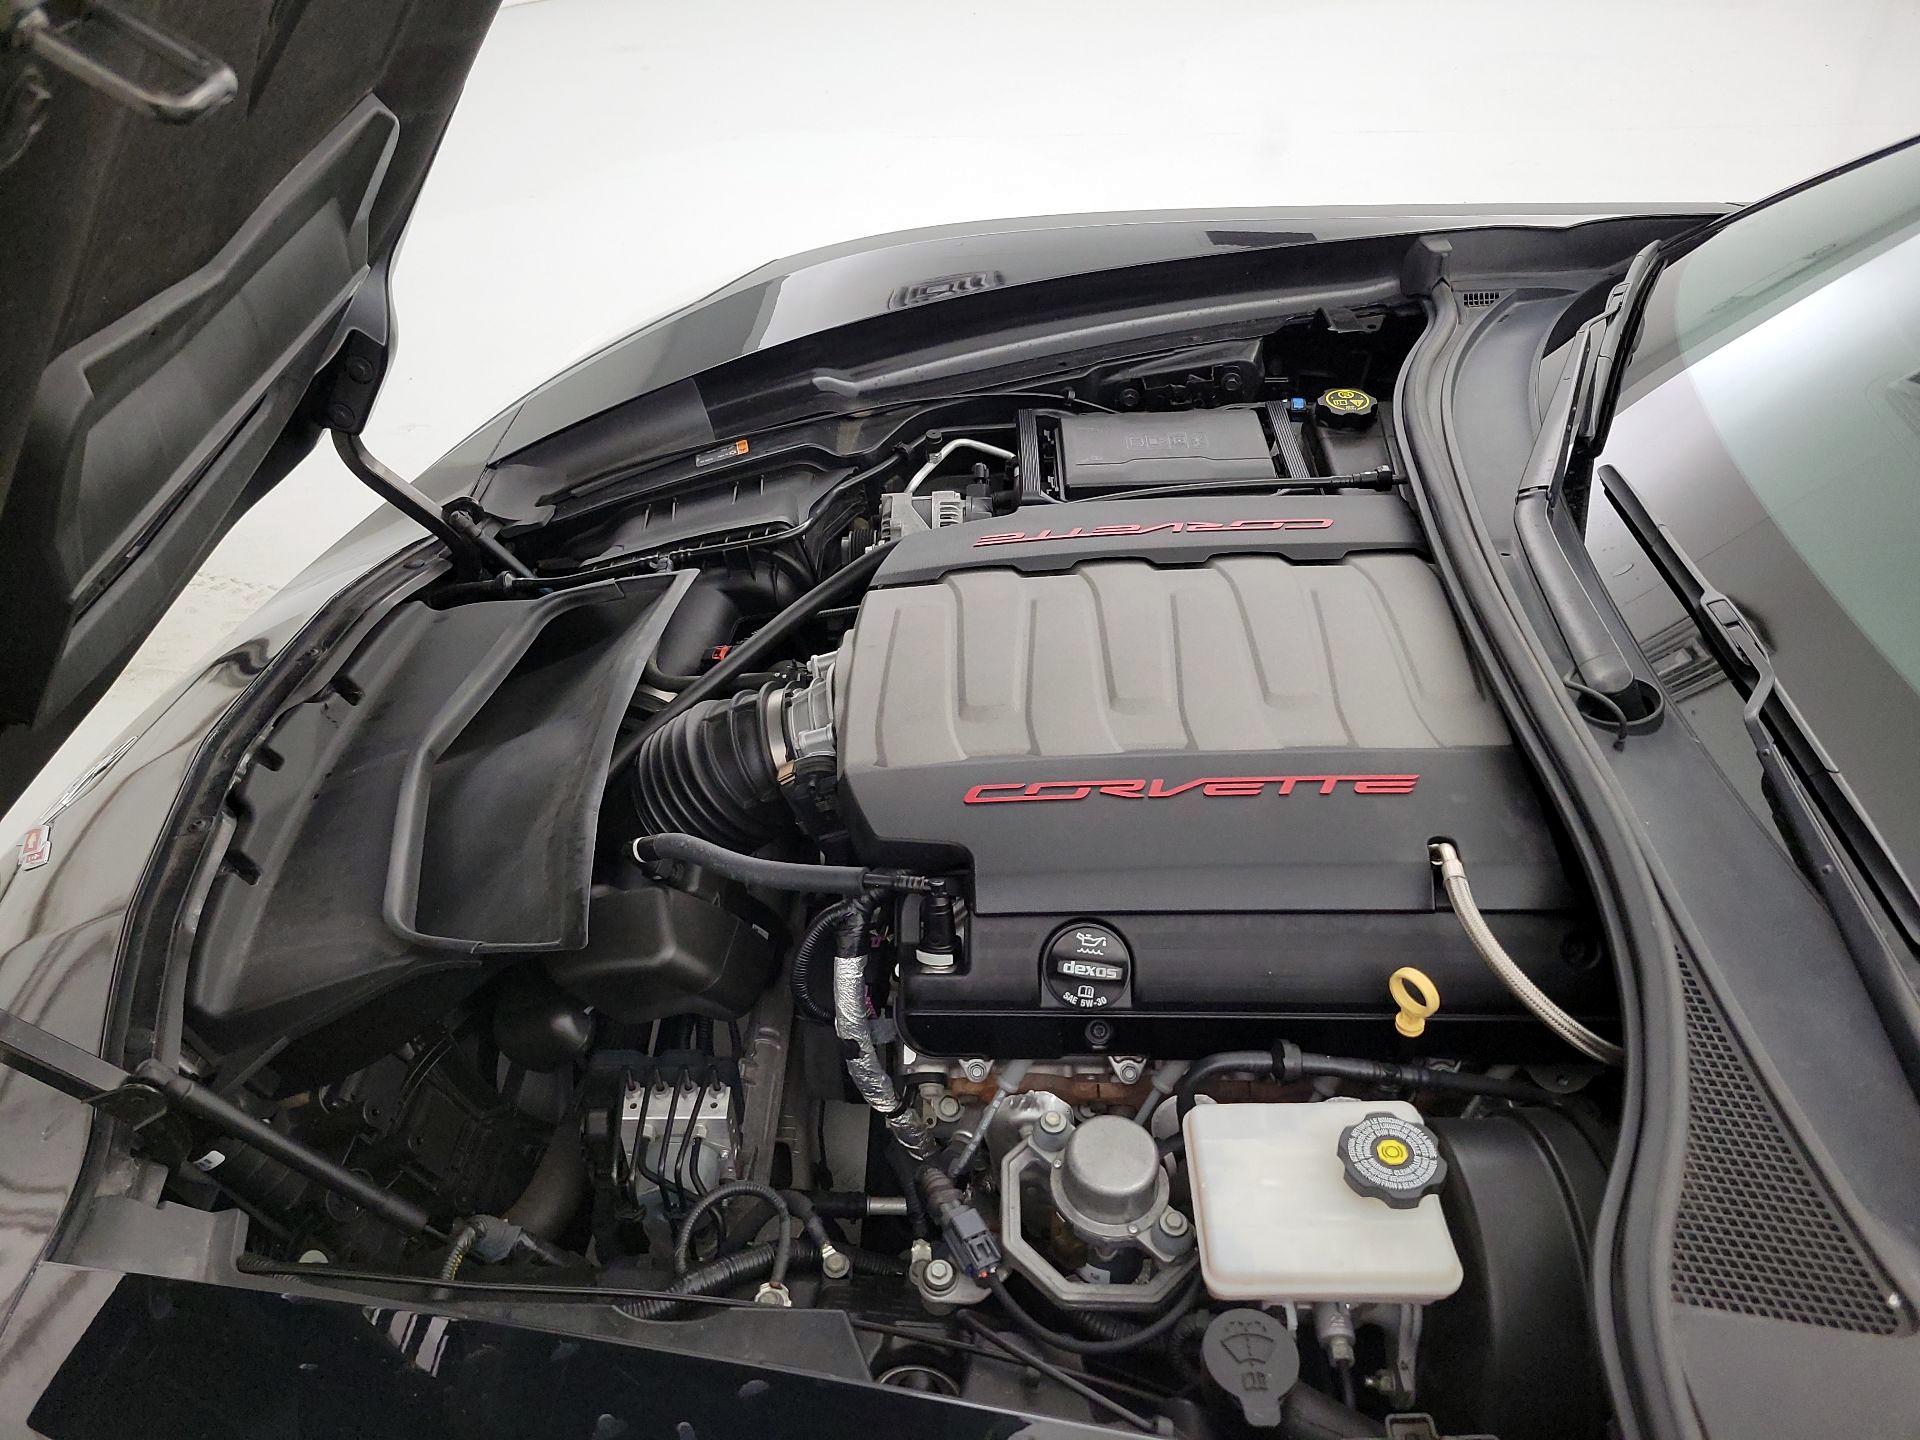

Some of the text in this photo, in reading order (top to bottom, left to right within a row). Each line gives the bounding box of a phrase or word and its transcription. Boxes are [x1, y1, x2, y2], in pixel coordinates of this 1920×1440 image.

[973, 519, 1335, 547] CORVETTE
[964, 774, 1420, 803] CORVETTE
[1063, 961, 1117, 978] dexos
[1063, 991, 1107, 1007] SAE 5W-30
